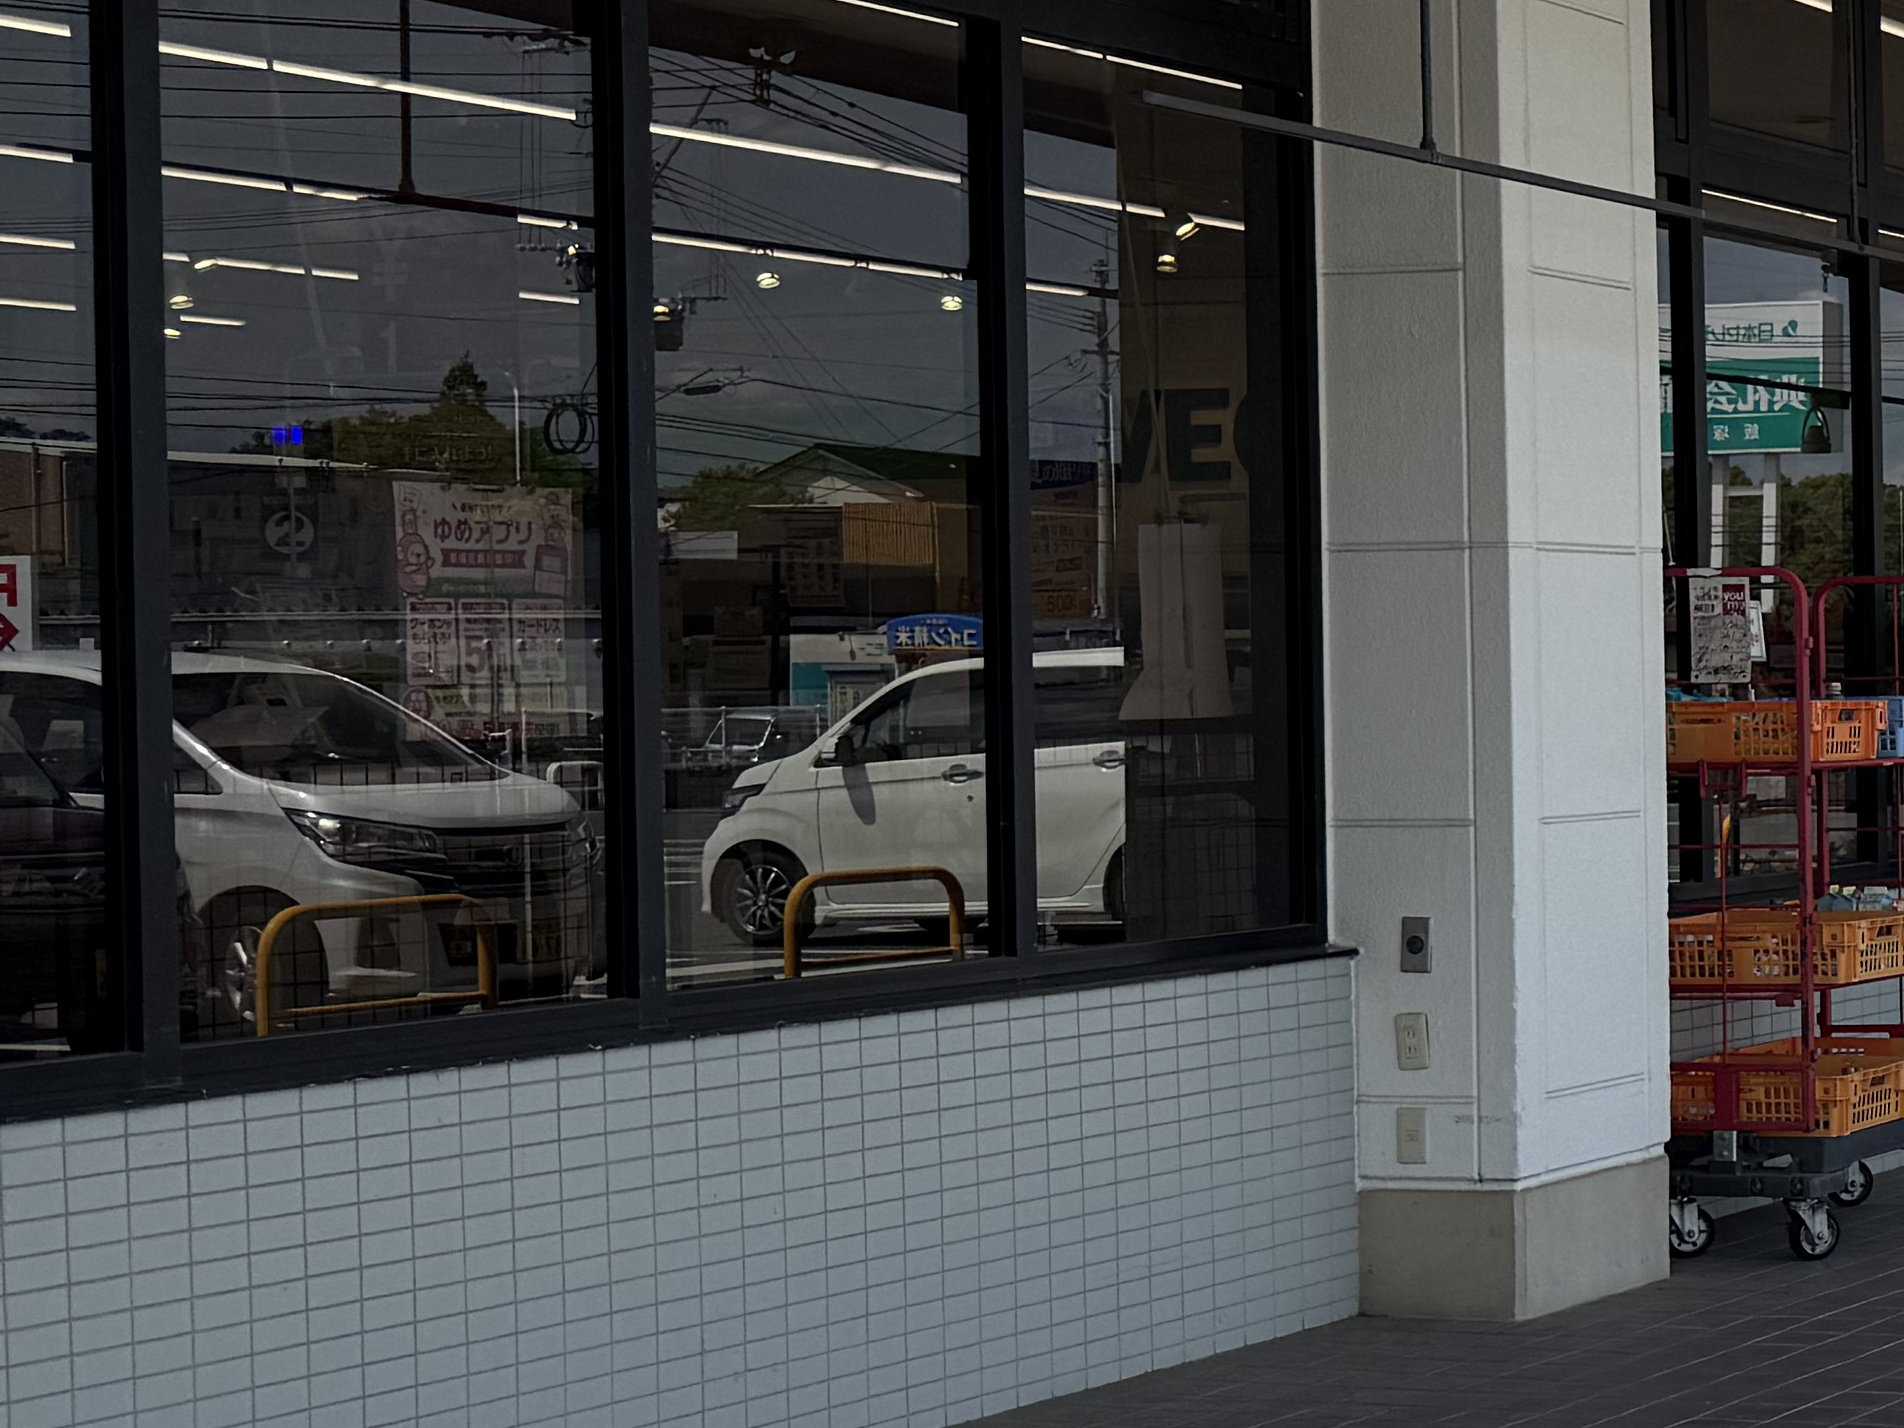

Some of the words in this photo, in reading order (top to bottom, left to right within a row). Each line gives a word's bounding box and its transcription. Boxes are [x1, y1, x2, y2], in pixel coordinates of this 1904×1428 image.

[434, 517, 532, 545] ゆめアプリ
[517, 618, 562, 635] カードレス
